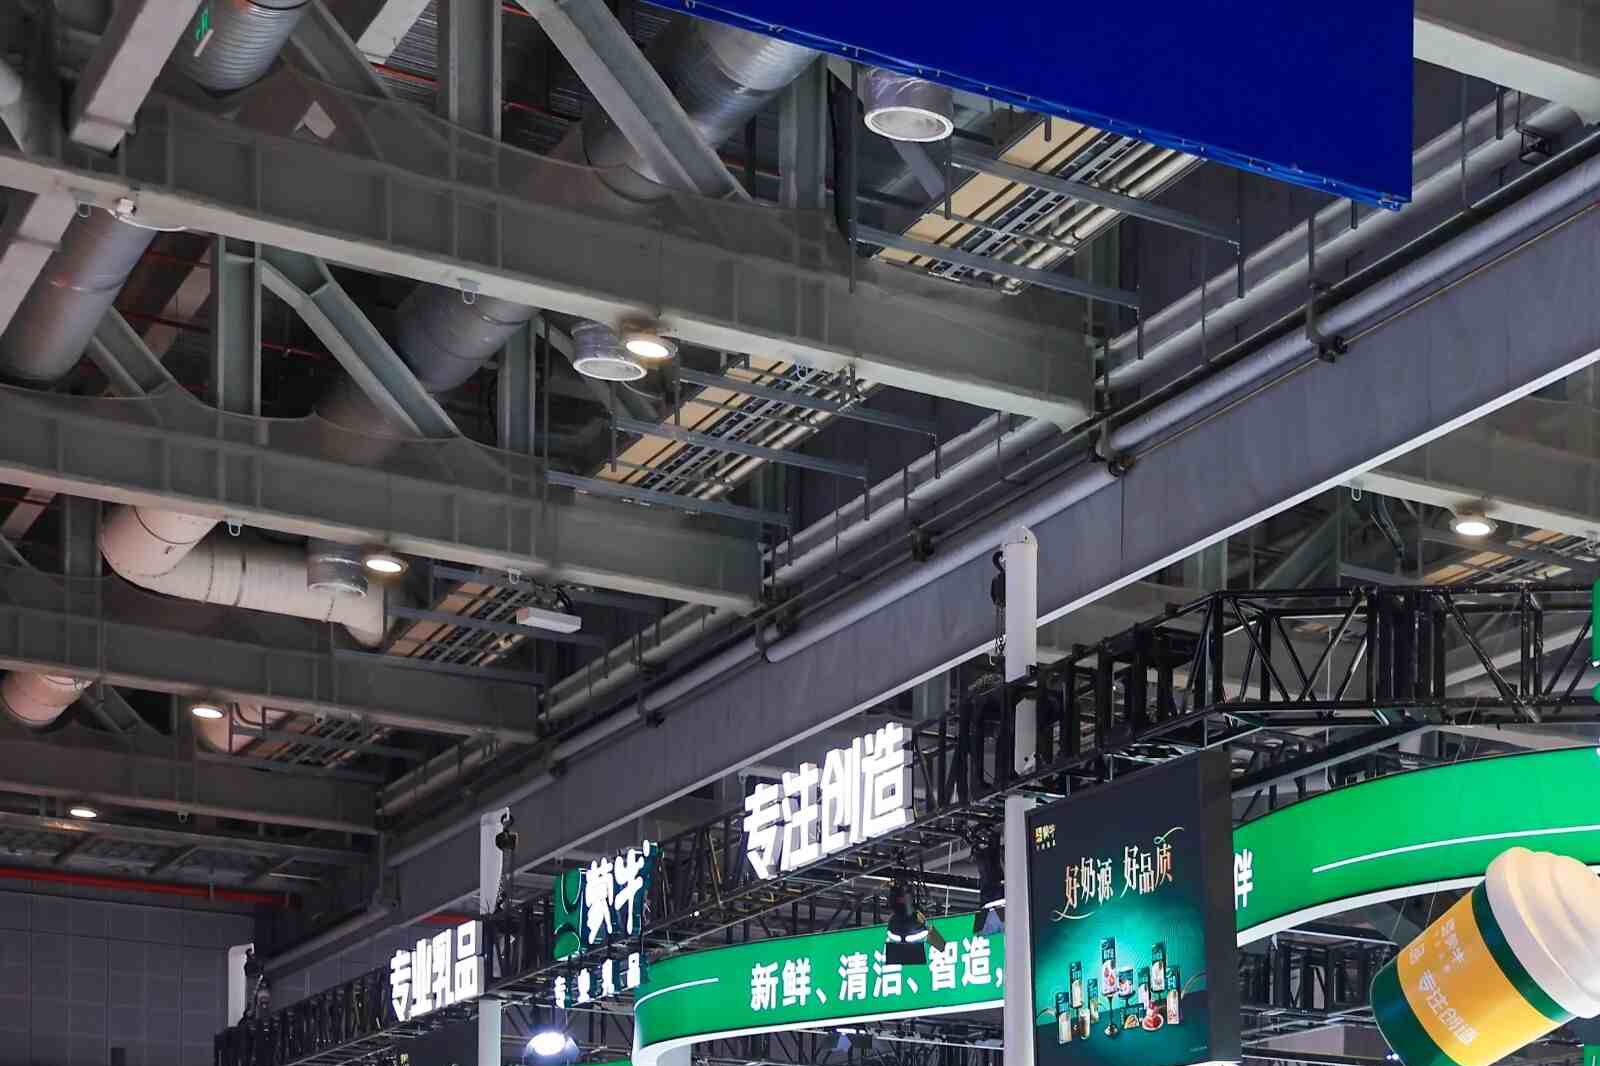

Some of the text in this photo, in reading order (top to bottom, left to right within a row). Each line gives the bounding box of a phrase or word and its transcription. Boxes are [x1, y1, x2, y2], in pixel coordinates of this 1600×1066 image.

[744, 722, 911, 880] 专注创造
[586, 850, 645, 944] 蒙牛
[390, 919, 483, 1022] 专业乳品
